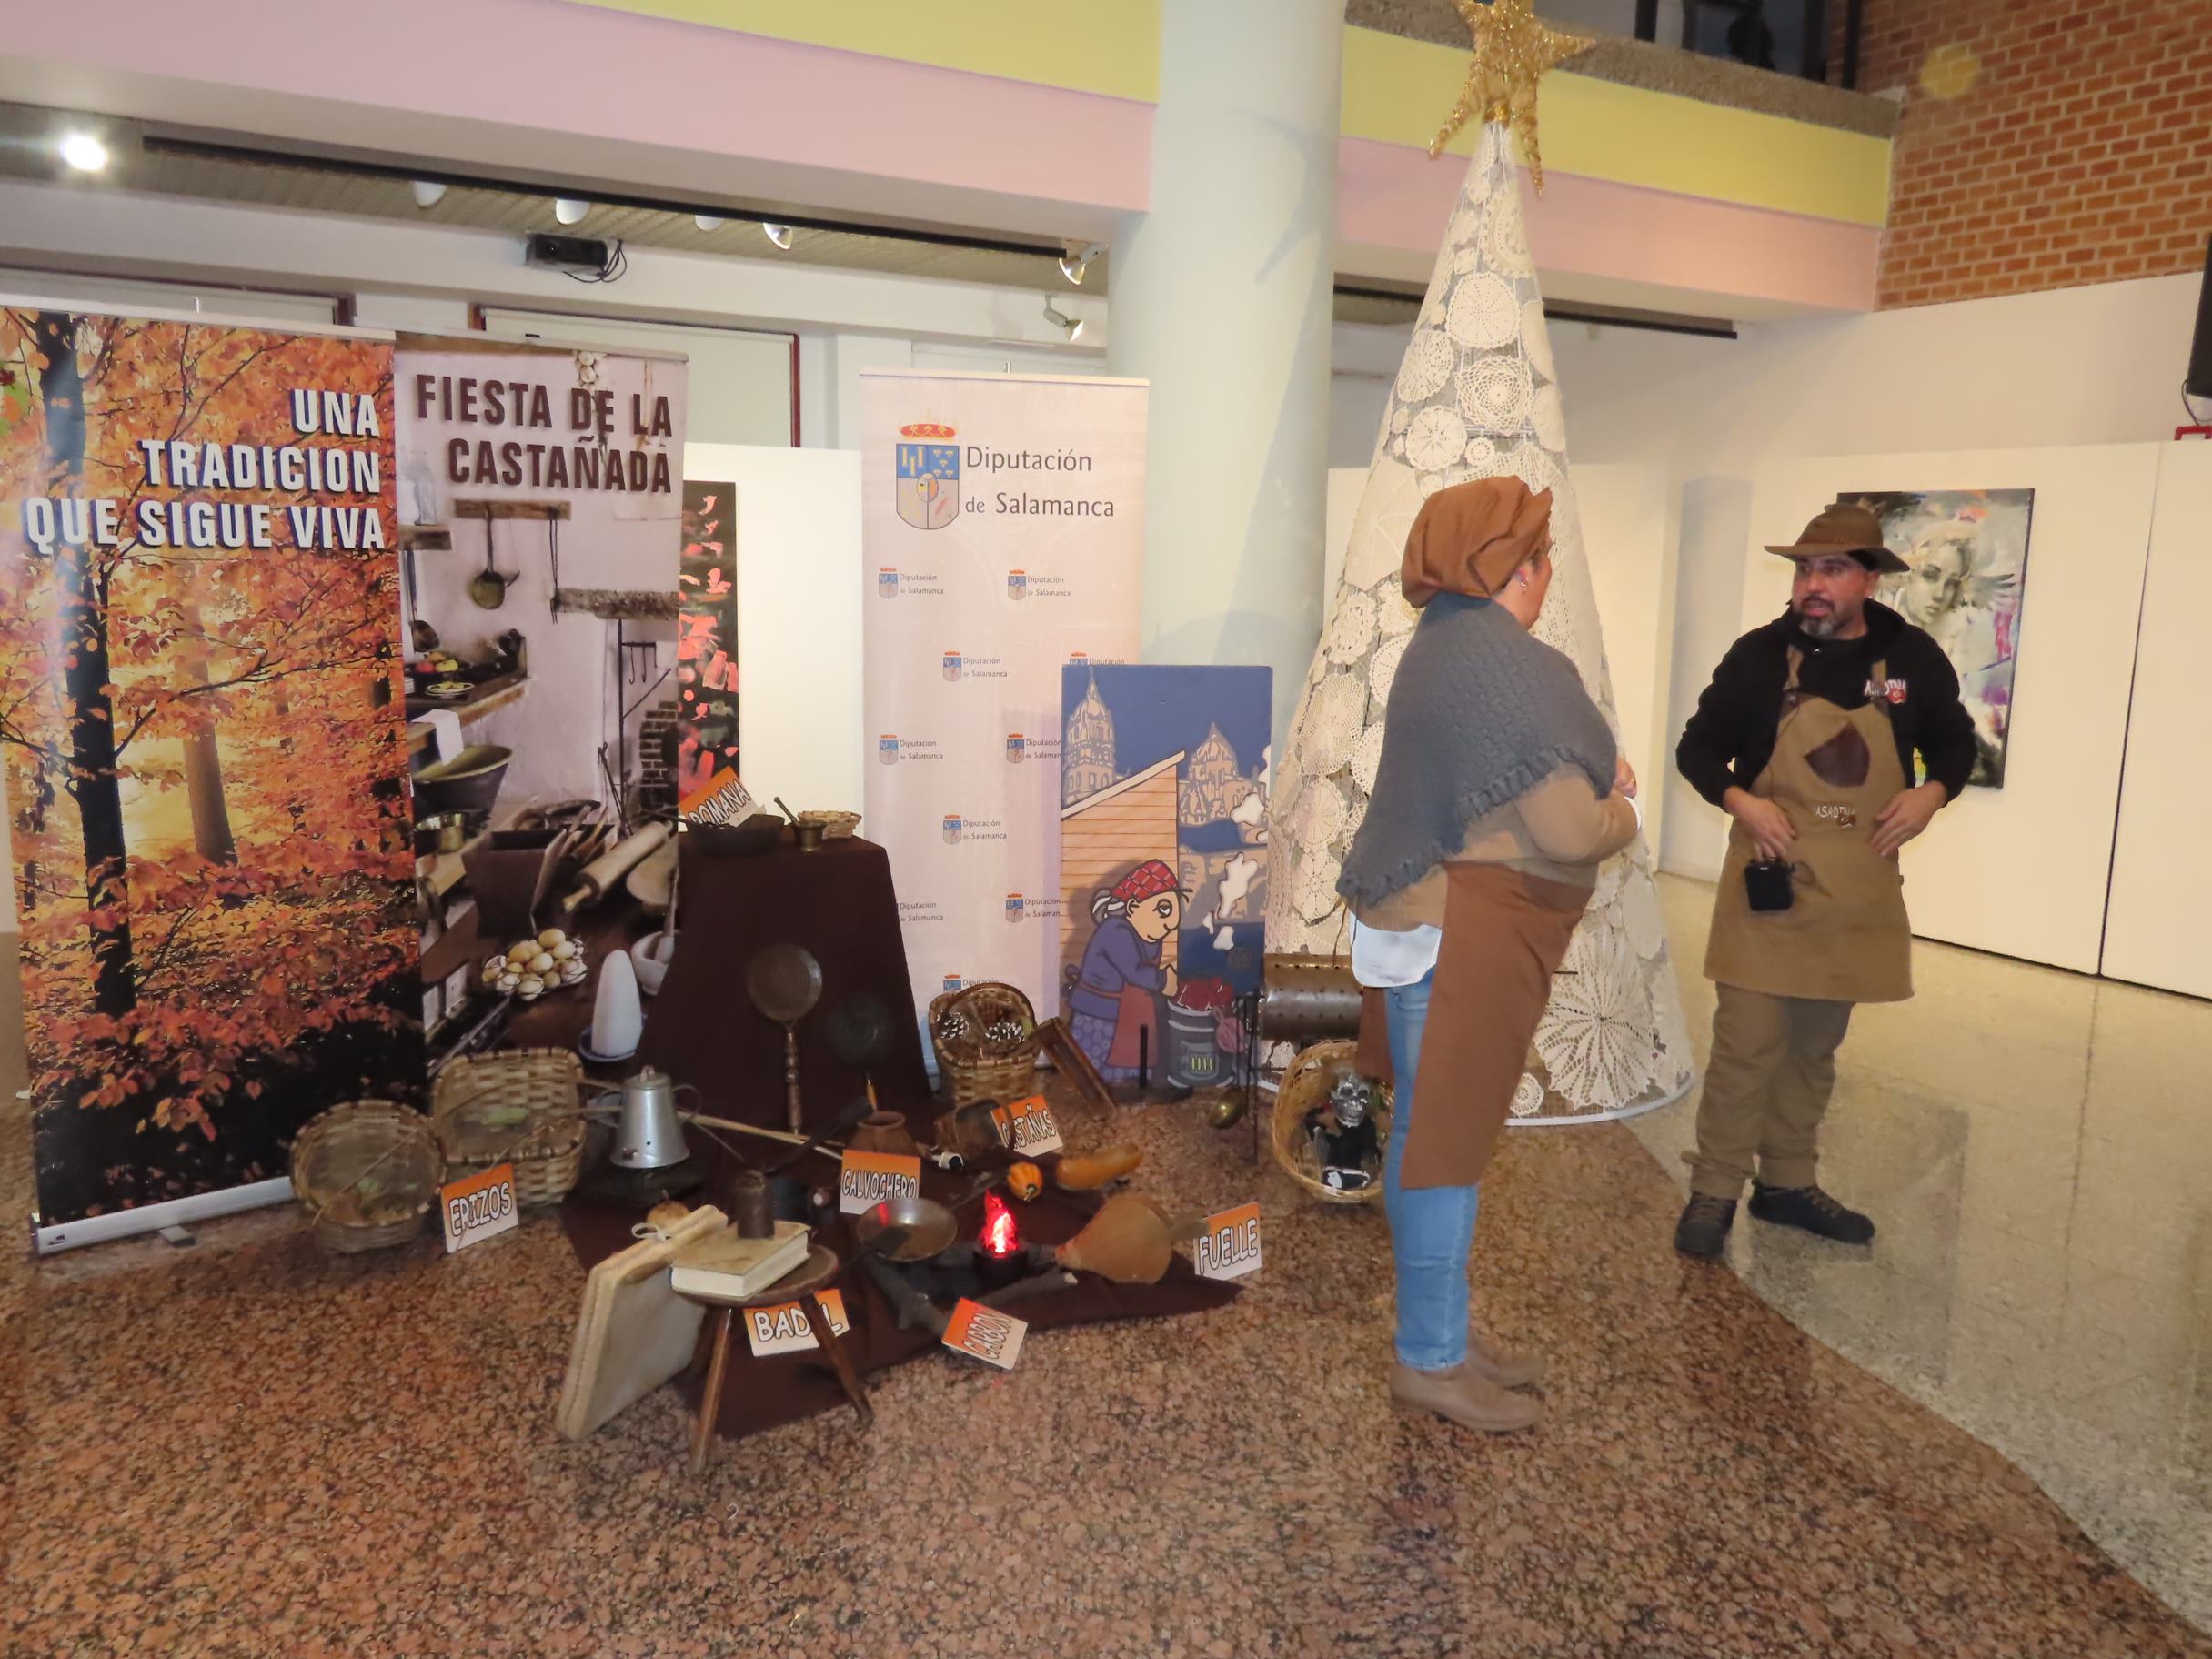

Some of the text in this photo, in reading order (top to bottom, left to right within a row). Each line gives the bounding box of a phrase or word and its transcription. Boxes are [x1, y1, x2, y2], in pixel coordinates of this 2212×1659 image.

[291, 388, 380, 437] UNA
[417, 374, 672, 437] FIESTA DE LA
[139, 439, 380, 494] TRADICION
[448, 435, 671, 493] CASTAÑADA
[966, 446, 1092, 474] Diputación
[965, 492, 1115, 518] de Salamanca
[24, 497, 385, 556] QUE SIGUE VIVA
[900, 573, 937, 582] Diputación
[1027, 576, 1064, 585] Diputación
[963, 657, 1000, 666] Diputación
[900, 739, 937, 749] Diputación
[1026, 739, 1061, 748] Diputación
[908, 752, 943, 760] Salamanca
[1034, 751, 1061, 759] Salaman
[963, 819, 1000, 829] Diputación
[971, 831, 1007, 840] Salamanca
[900, 901, 937, 910] Diputación
[1032, 910, 1061, 918] Salaman
[908, 914, 943, 922] Salamanca
[1001, 1103, 1056, 1150] CSTAÑAS
[842, 1169, 918, 1201] CALVOCHERO
[448, 1181, 512, 1237] ERIZOS
[1199, 1217, 1259, 1275] FUELLE
[754, 1302, 843, 1342] BADL
